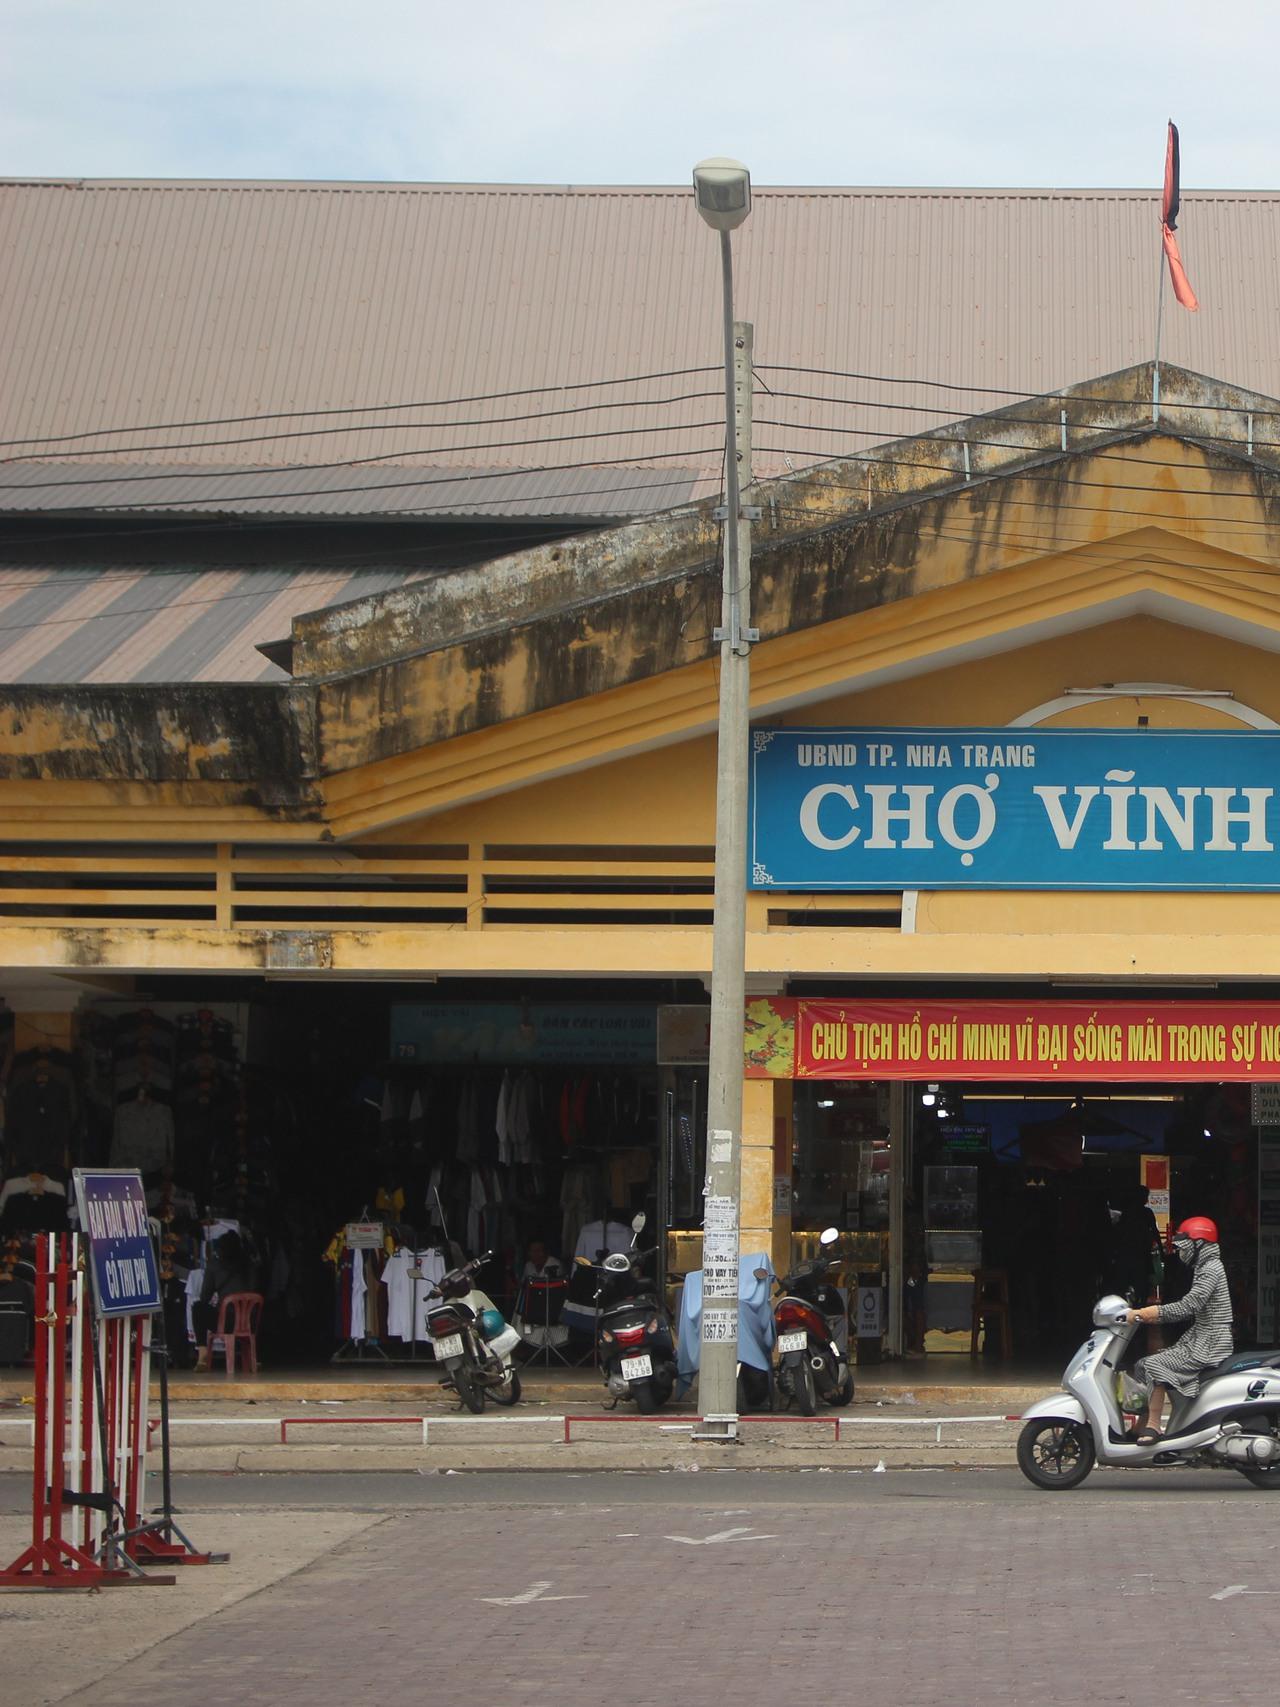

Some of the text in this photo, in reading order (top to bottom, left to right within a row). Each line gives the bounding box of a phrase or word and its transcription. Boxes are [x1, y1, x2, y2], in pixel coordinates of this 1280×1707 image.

[798, 744, 1036, 768] UBND TP. NHA TRANG
[799, 772, 999, 867] CHỢ
[1033, 769, 1274, 854] VĨNH
[811, 1011, 848, 1060] CHỦ
[852, 1022, 893, 1069] TỊCH
[897, 1011, 922, 1061] HỒ
[927, 1015, 957, 1061] CHÍ
[962, 1023, 1011, 1061] MINH
[1015, 1017, 1034, 1061] VĨ
[1037, 1024, 1068, 1070] ĐẠI
[1073, 1011, 1122, 1062] SỐNG
[1127, 1017, 1162, 1062] MÃI
[1167, 1024, 1226, 1062] TRONG
[1231, 1021, 1258, 1070] SỰ
[88, 1193, 107, 1240] BÃI
[106, 1249, 151, 1299] CÓ THU PHÍ
